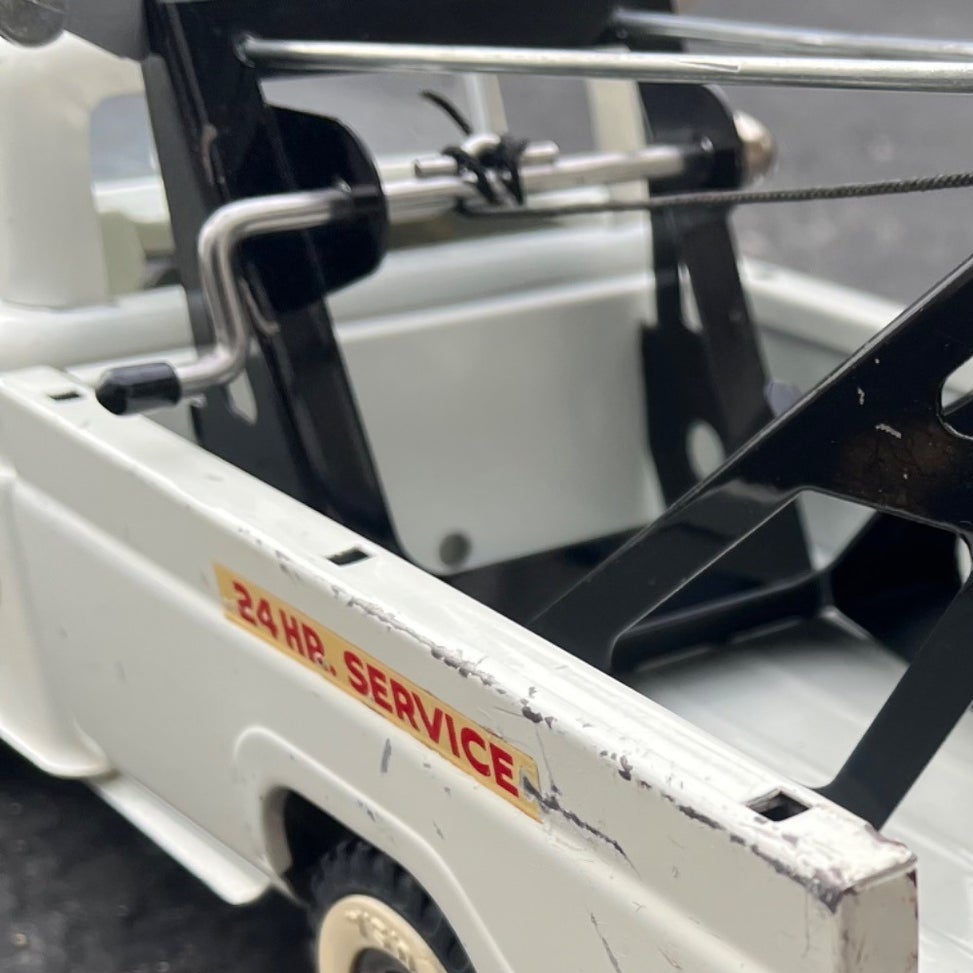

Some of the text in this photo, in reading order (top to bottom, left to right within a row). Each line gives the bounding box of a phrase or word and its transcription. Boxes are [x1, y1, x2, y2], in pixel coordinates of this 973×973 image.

[232, 581, 520, 798] 24 HR. SERVICE
